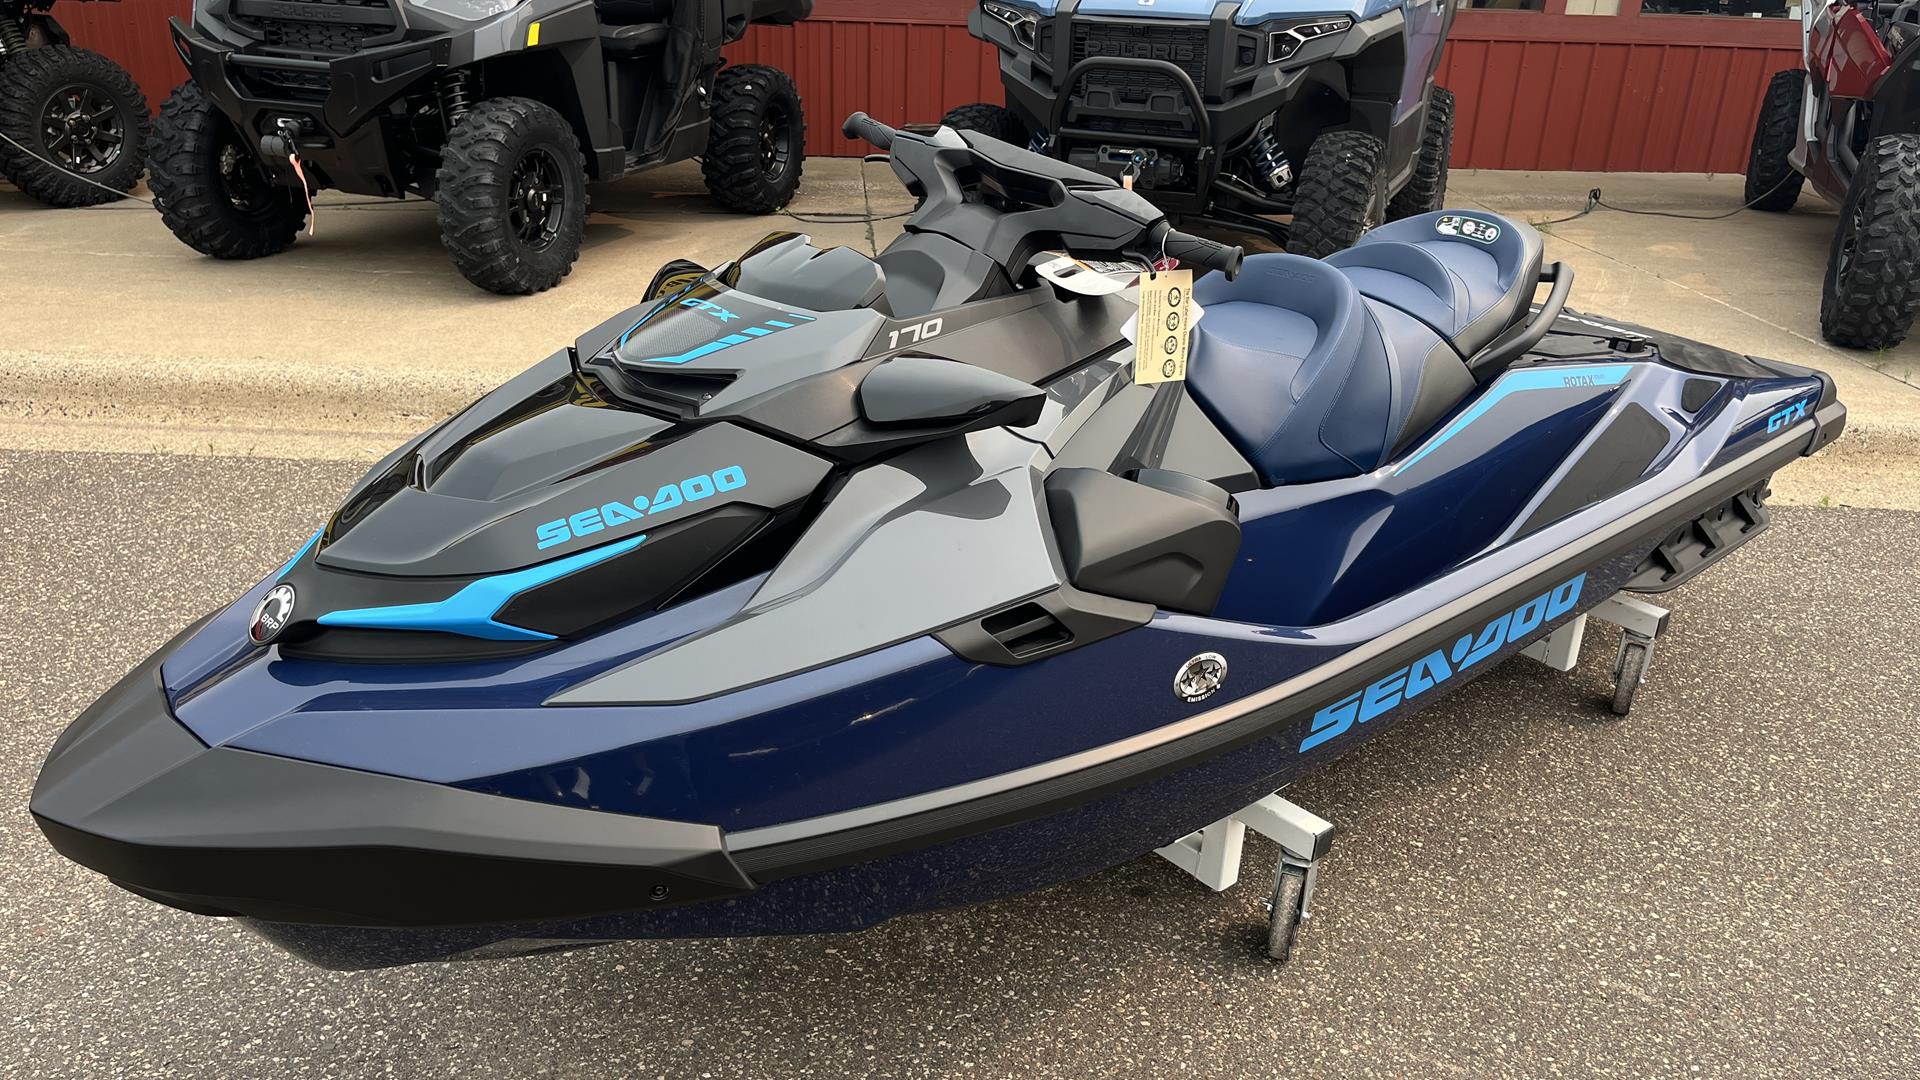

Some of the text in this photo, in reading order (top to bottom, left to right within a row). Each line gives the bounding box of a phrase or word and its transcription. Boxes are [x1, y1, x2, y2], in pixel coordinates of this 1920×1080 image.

[1084, 40, 1194, 61] POLARIS
[679, 298, 740, 323] GTX
[889, 317, 943, 349] 170
[1563, 374, 1595, 388] ROTAX
[1767, 398, 1809, 434] GTX
[260, 612, 279, 630] BRP
[1187, 688, 1216, 703] EMISSION
